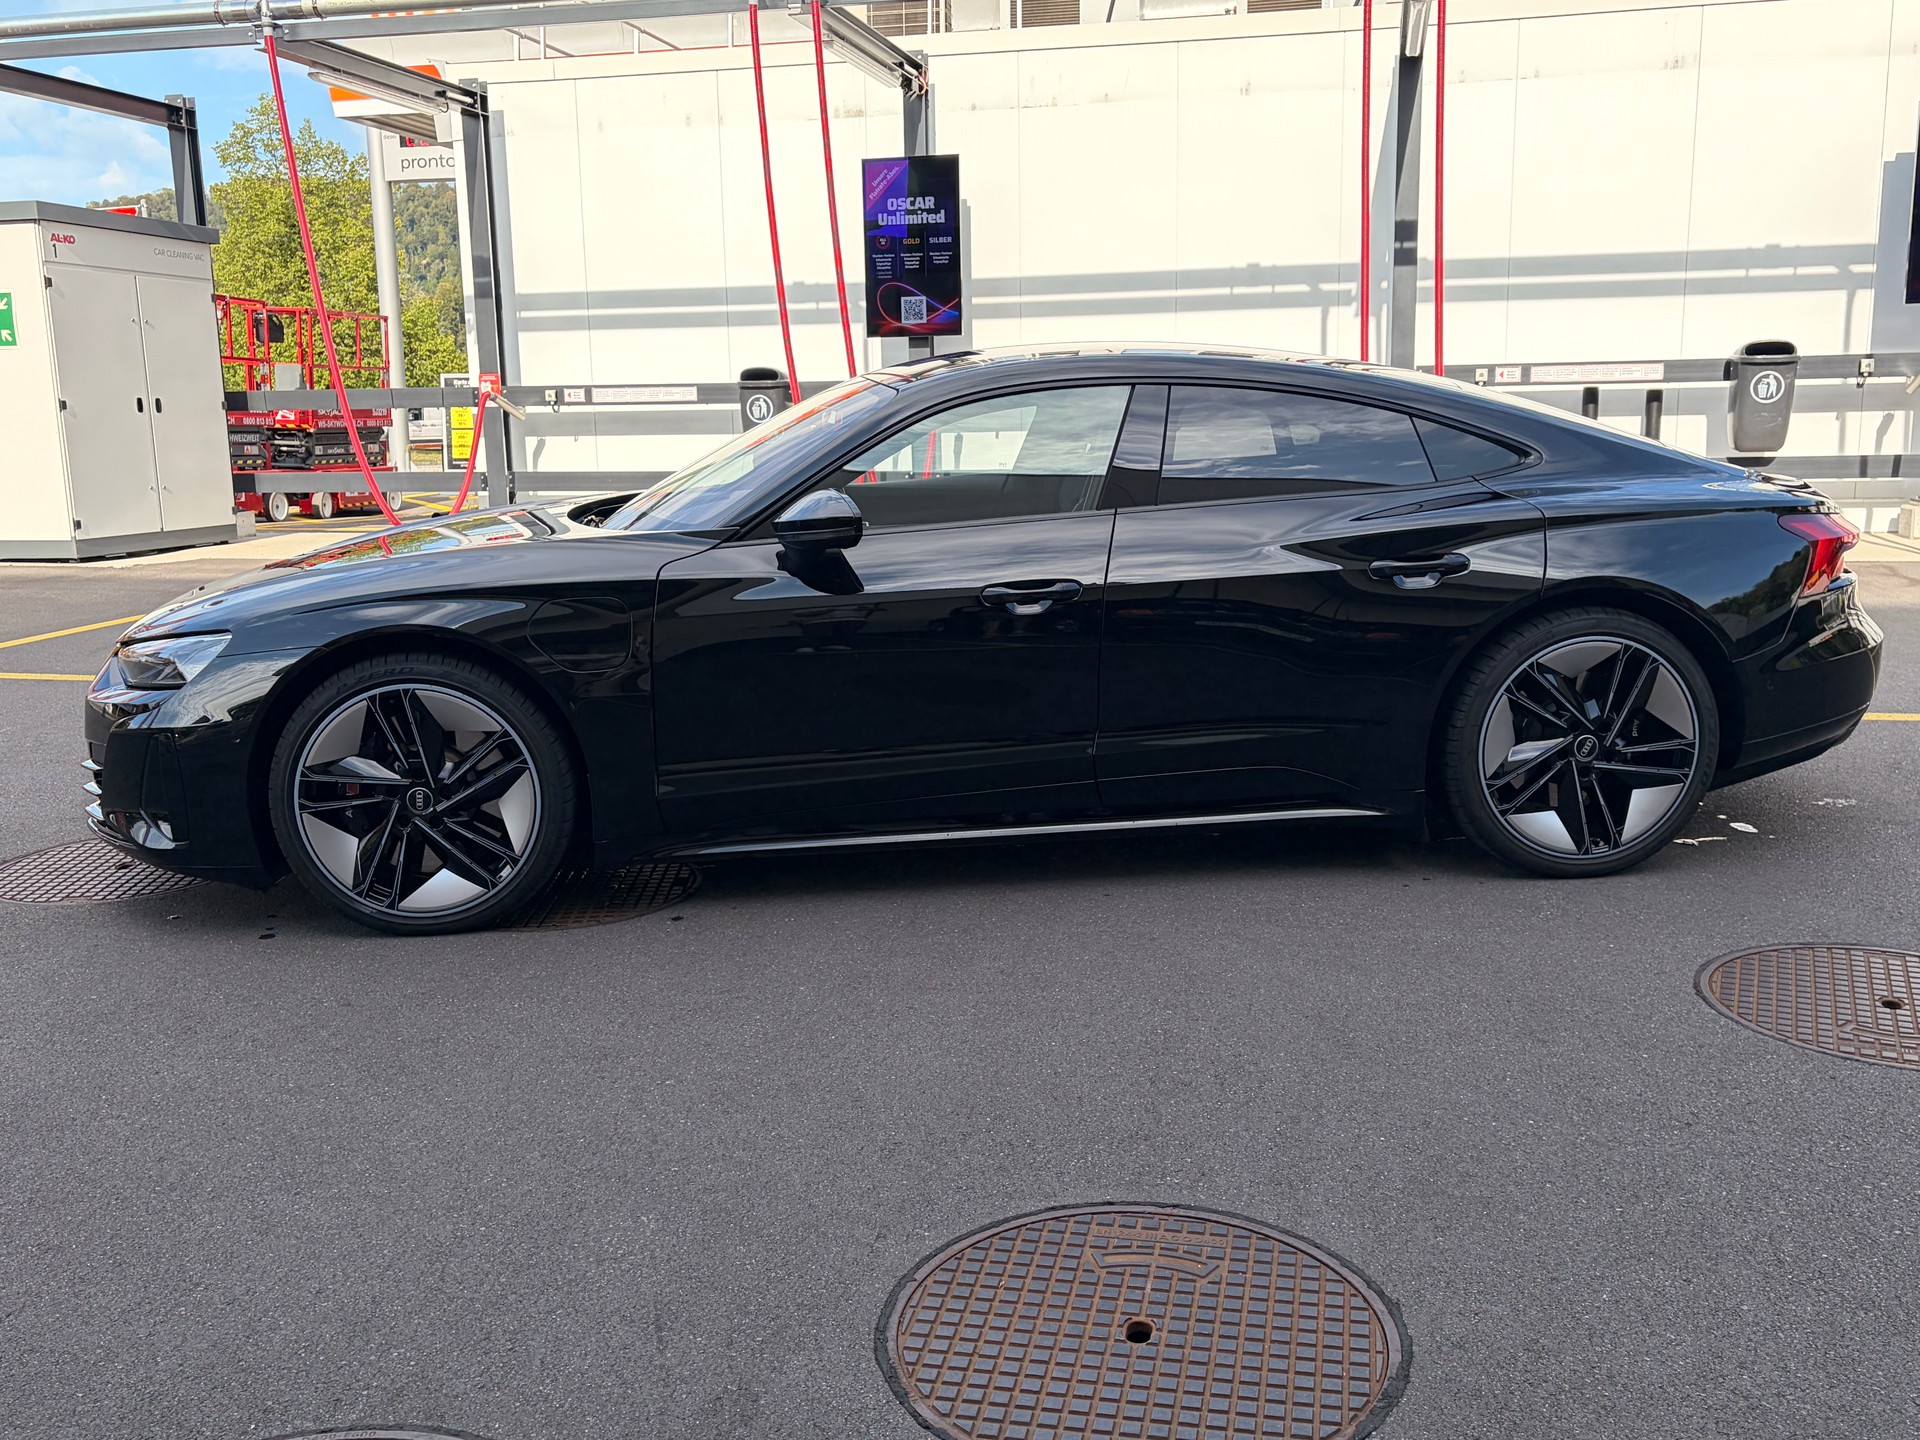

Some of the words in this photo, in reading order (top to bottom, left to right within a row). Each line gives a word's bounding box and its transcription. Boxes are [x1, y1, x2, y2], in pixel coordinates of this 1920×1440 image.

[401, 154, 455, 172] pronto
[872, 169, 888, 187] Unsere
[887, 196, 935, 211] OSCAR
[878, 209, 946, 226] Unlimited
[902, 237, 920, 245] GOLD
[929, 236, 952, 244] SILBER
[52, 243, 58, 258] 1
[153, 248, 165, 256] CAR
[166, 249, 193, 260] CLEANING
[193, 253, 205, 262] VAC
[1632, 719, 1640, 737] Aud
